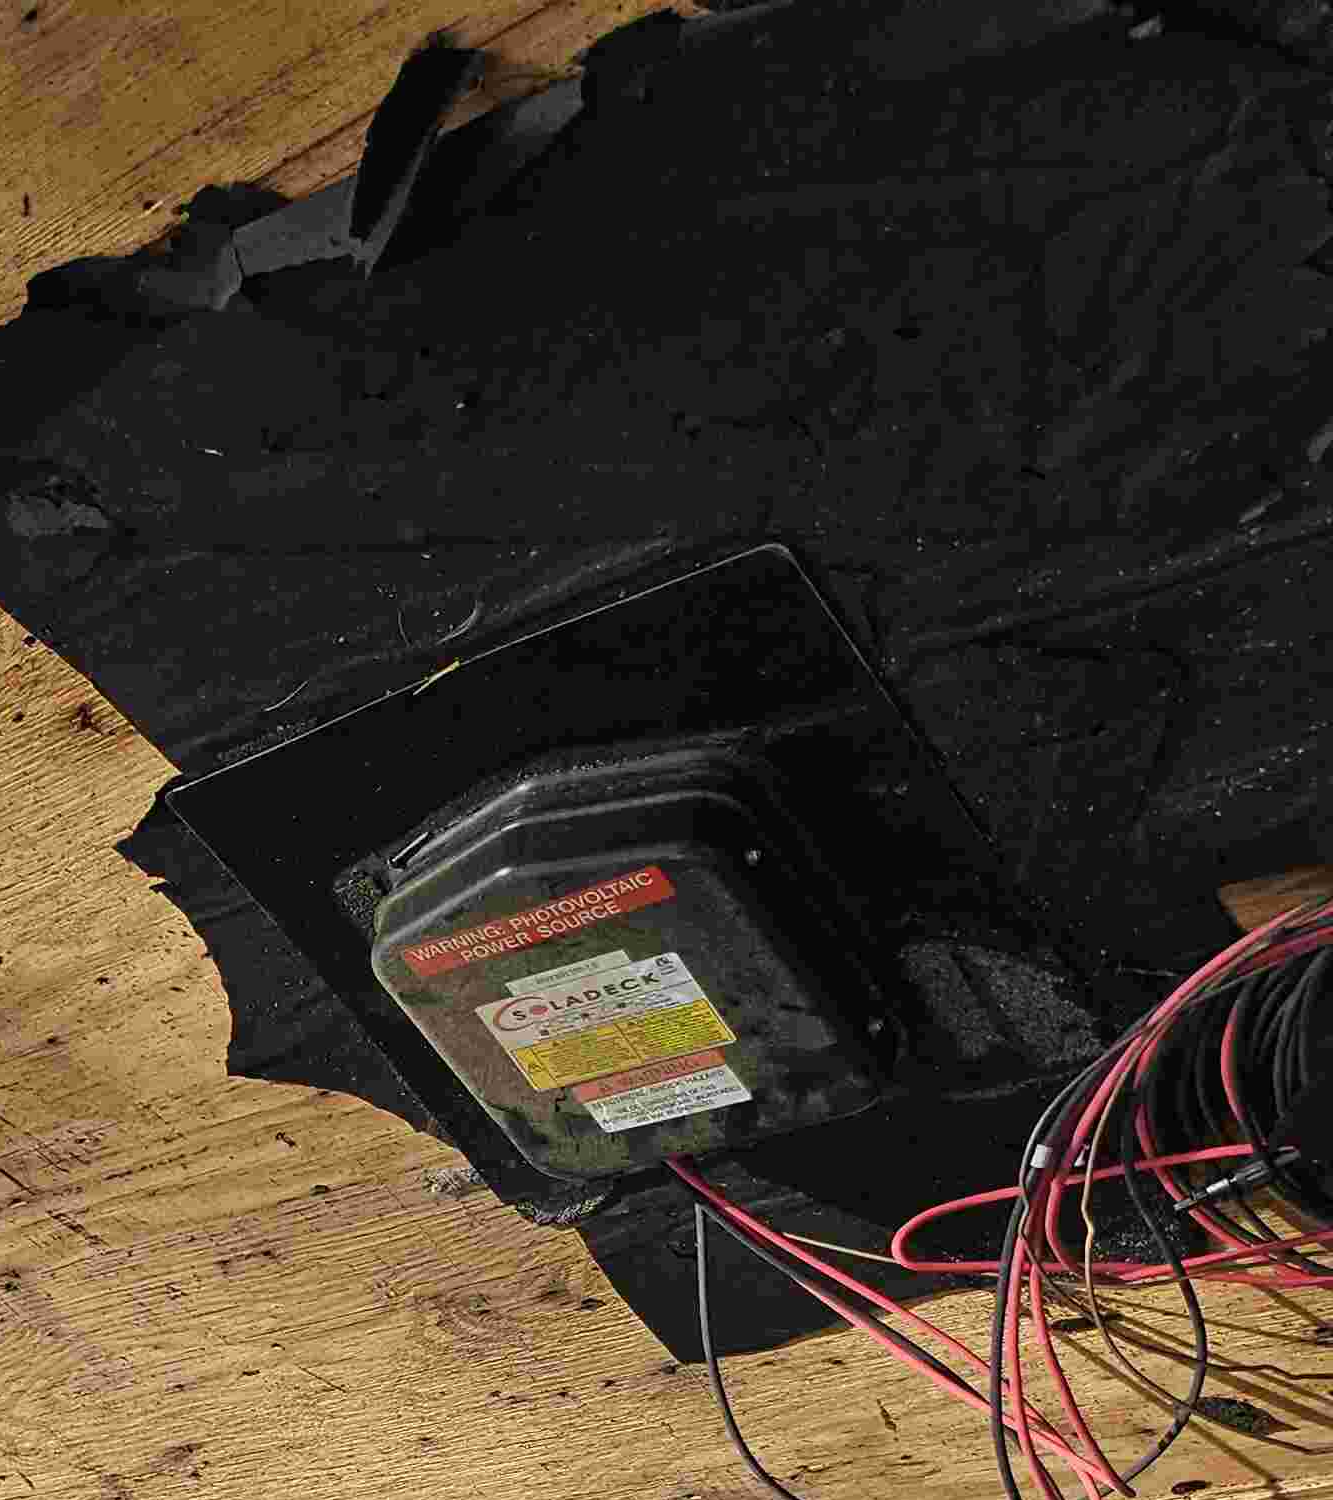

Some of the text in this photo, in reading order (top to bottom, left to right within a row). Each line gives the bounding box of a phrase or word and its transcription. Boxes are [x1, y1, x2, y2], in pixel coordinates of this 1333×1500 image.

[411, 871, 655, 962] WARNING: PHOTOVOLTAIC
[460, 899, 621, 963] POWER SOURCE
[512, 971, 661, 1022] SOLADECK
